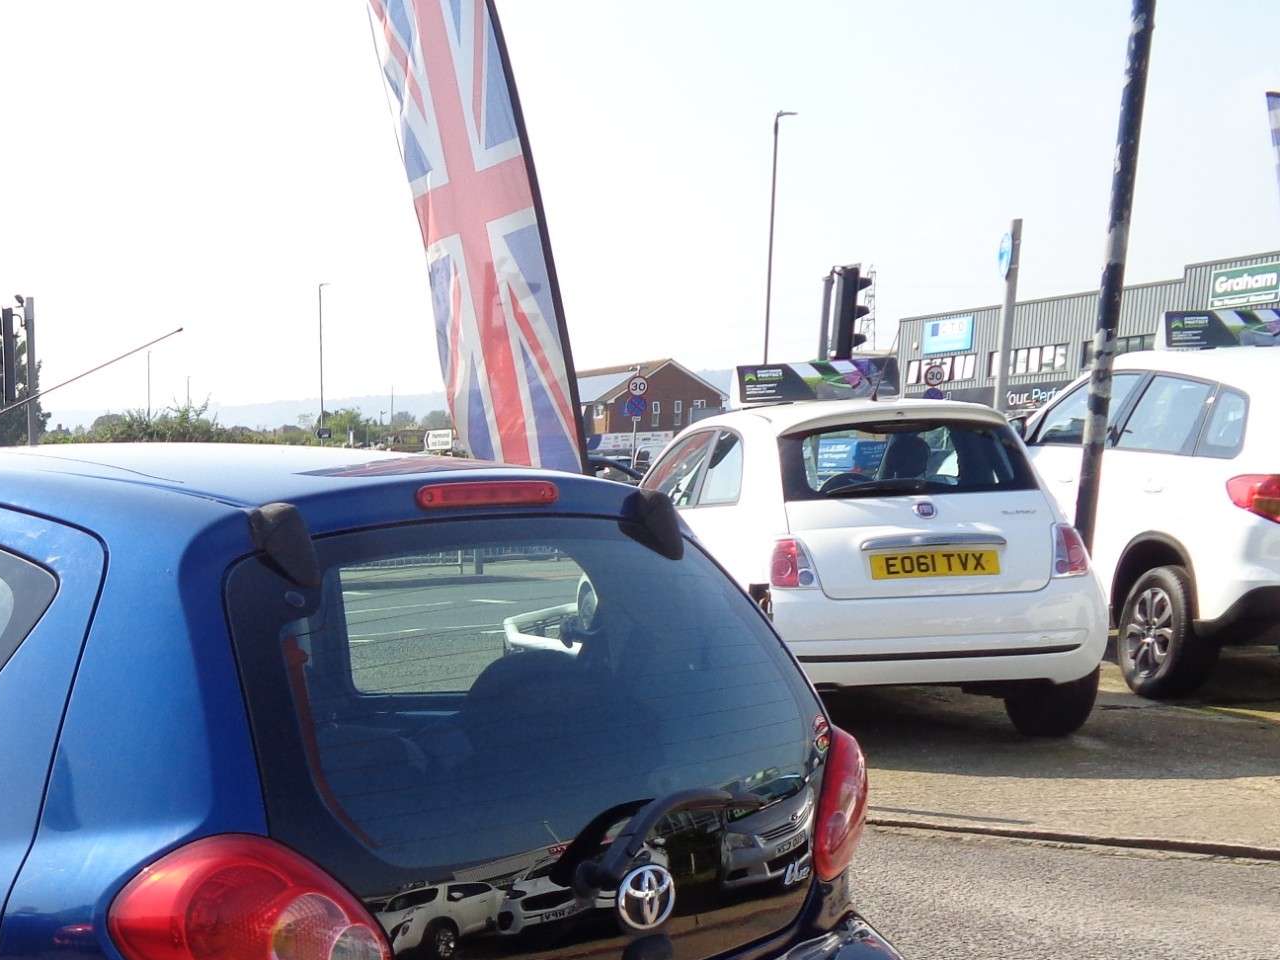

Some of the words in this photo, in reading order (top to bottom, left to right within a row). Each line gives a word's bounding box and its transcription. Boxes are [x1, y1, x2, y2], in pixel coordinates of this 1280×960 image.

[1215, 272, 1278, 293] Graham
[928, 370, 942, 380] 30
[631, 382, 646, 391] 30
[884, 554, 937, 575] EO61
[942, 552, 986, 572] TVX
